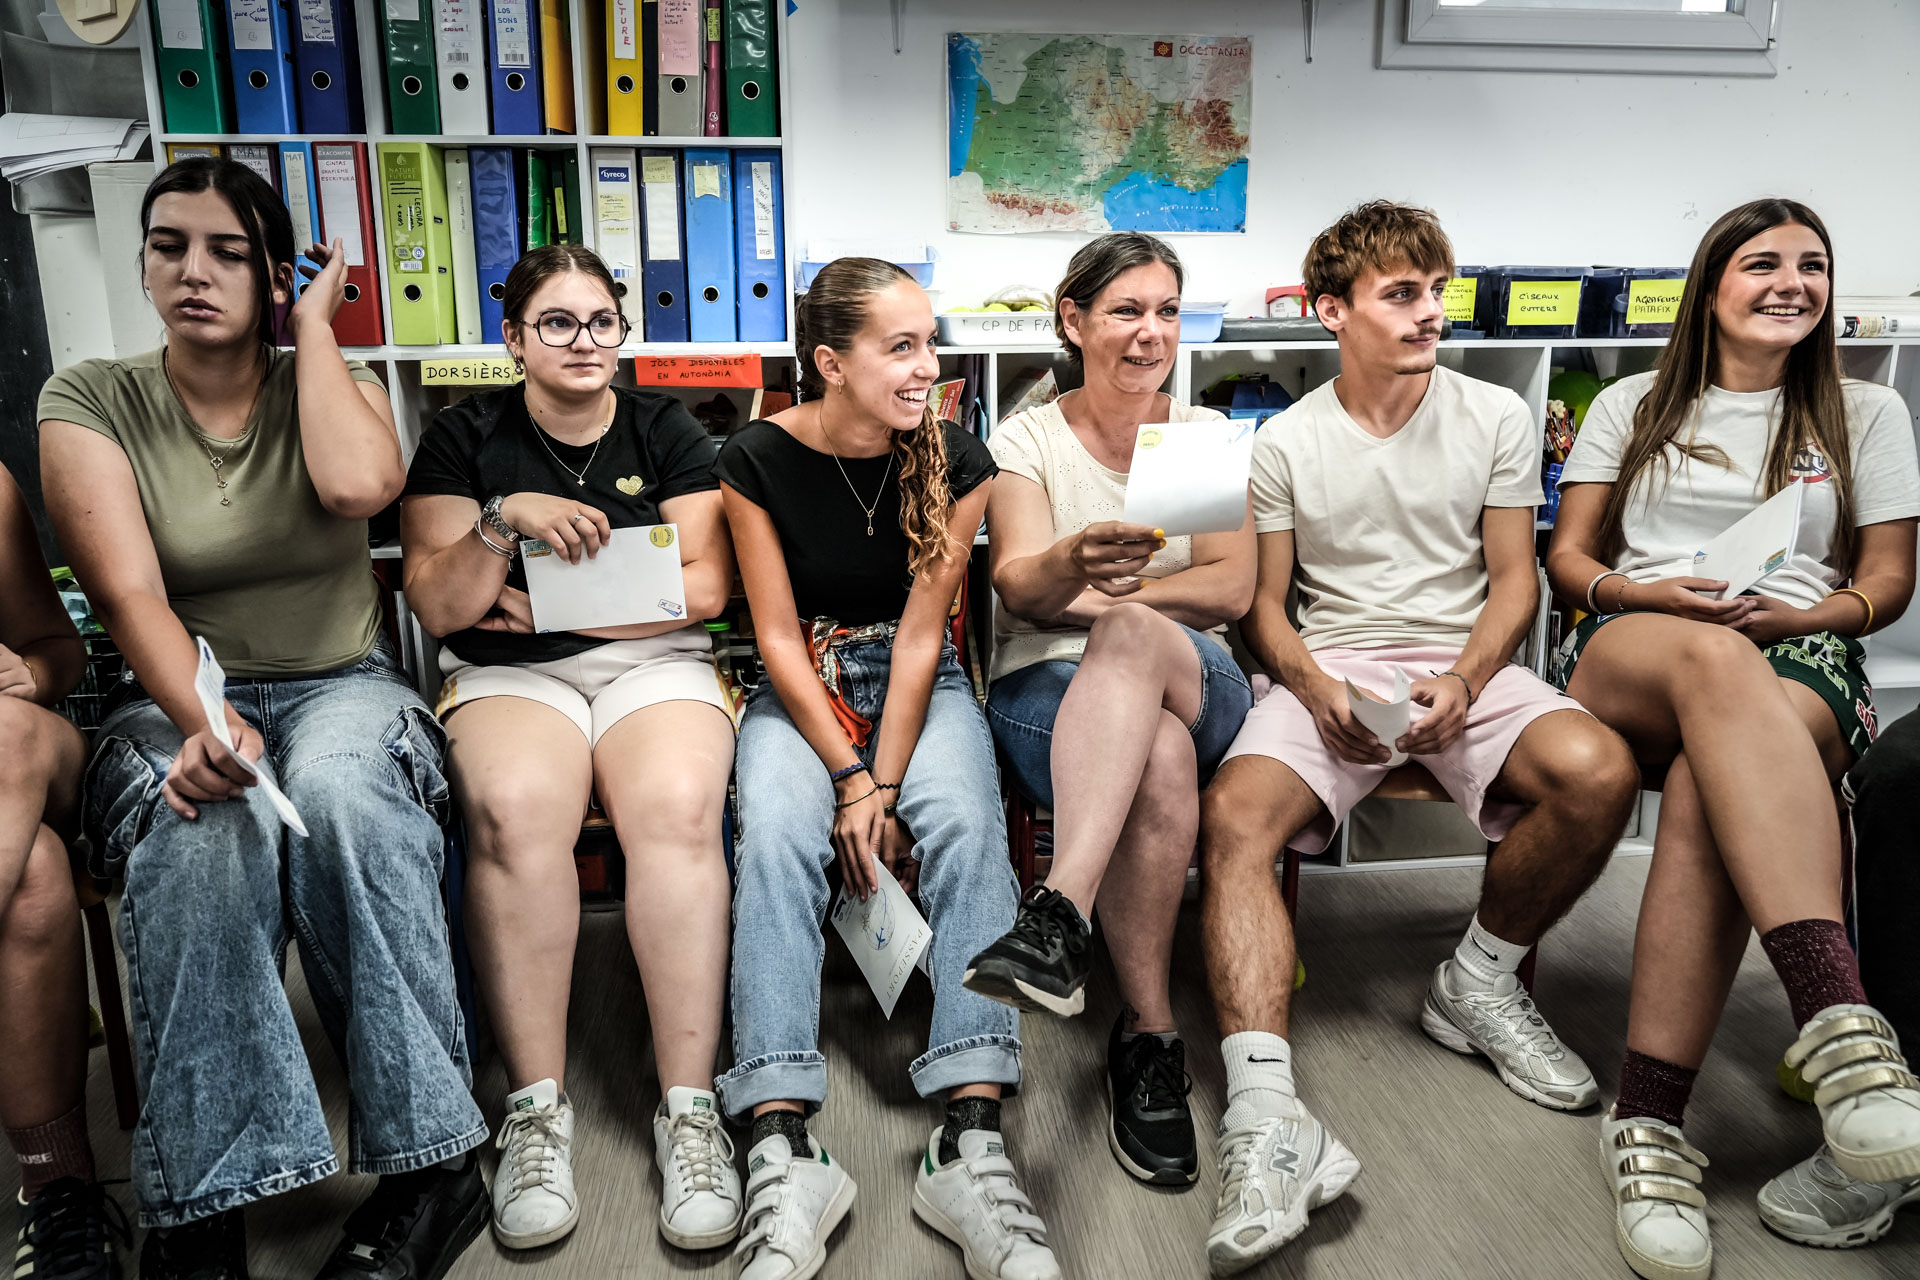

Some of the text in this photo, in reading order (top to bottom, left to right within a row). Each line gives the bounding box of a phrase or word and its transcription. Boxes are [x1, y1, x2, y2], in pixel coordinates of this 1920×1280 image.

[1179, 45, 1245, 57] OCCITANIA
[285, 153, 303, 161] MAT
[414, 197, 424, 227] LECTURA
[982, 320, 1000, 331] CP
[1008, 319, 1025, 332] DE
[887, 928, 923, 1000] PASSEPORT
